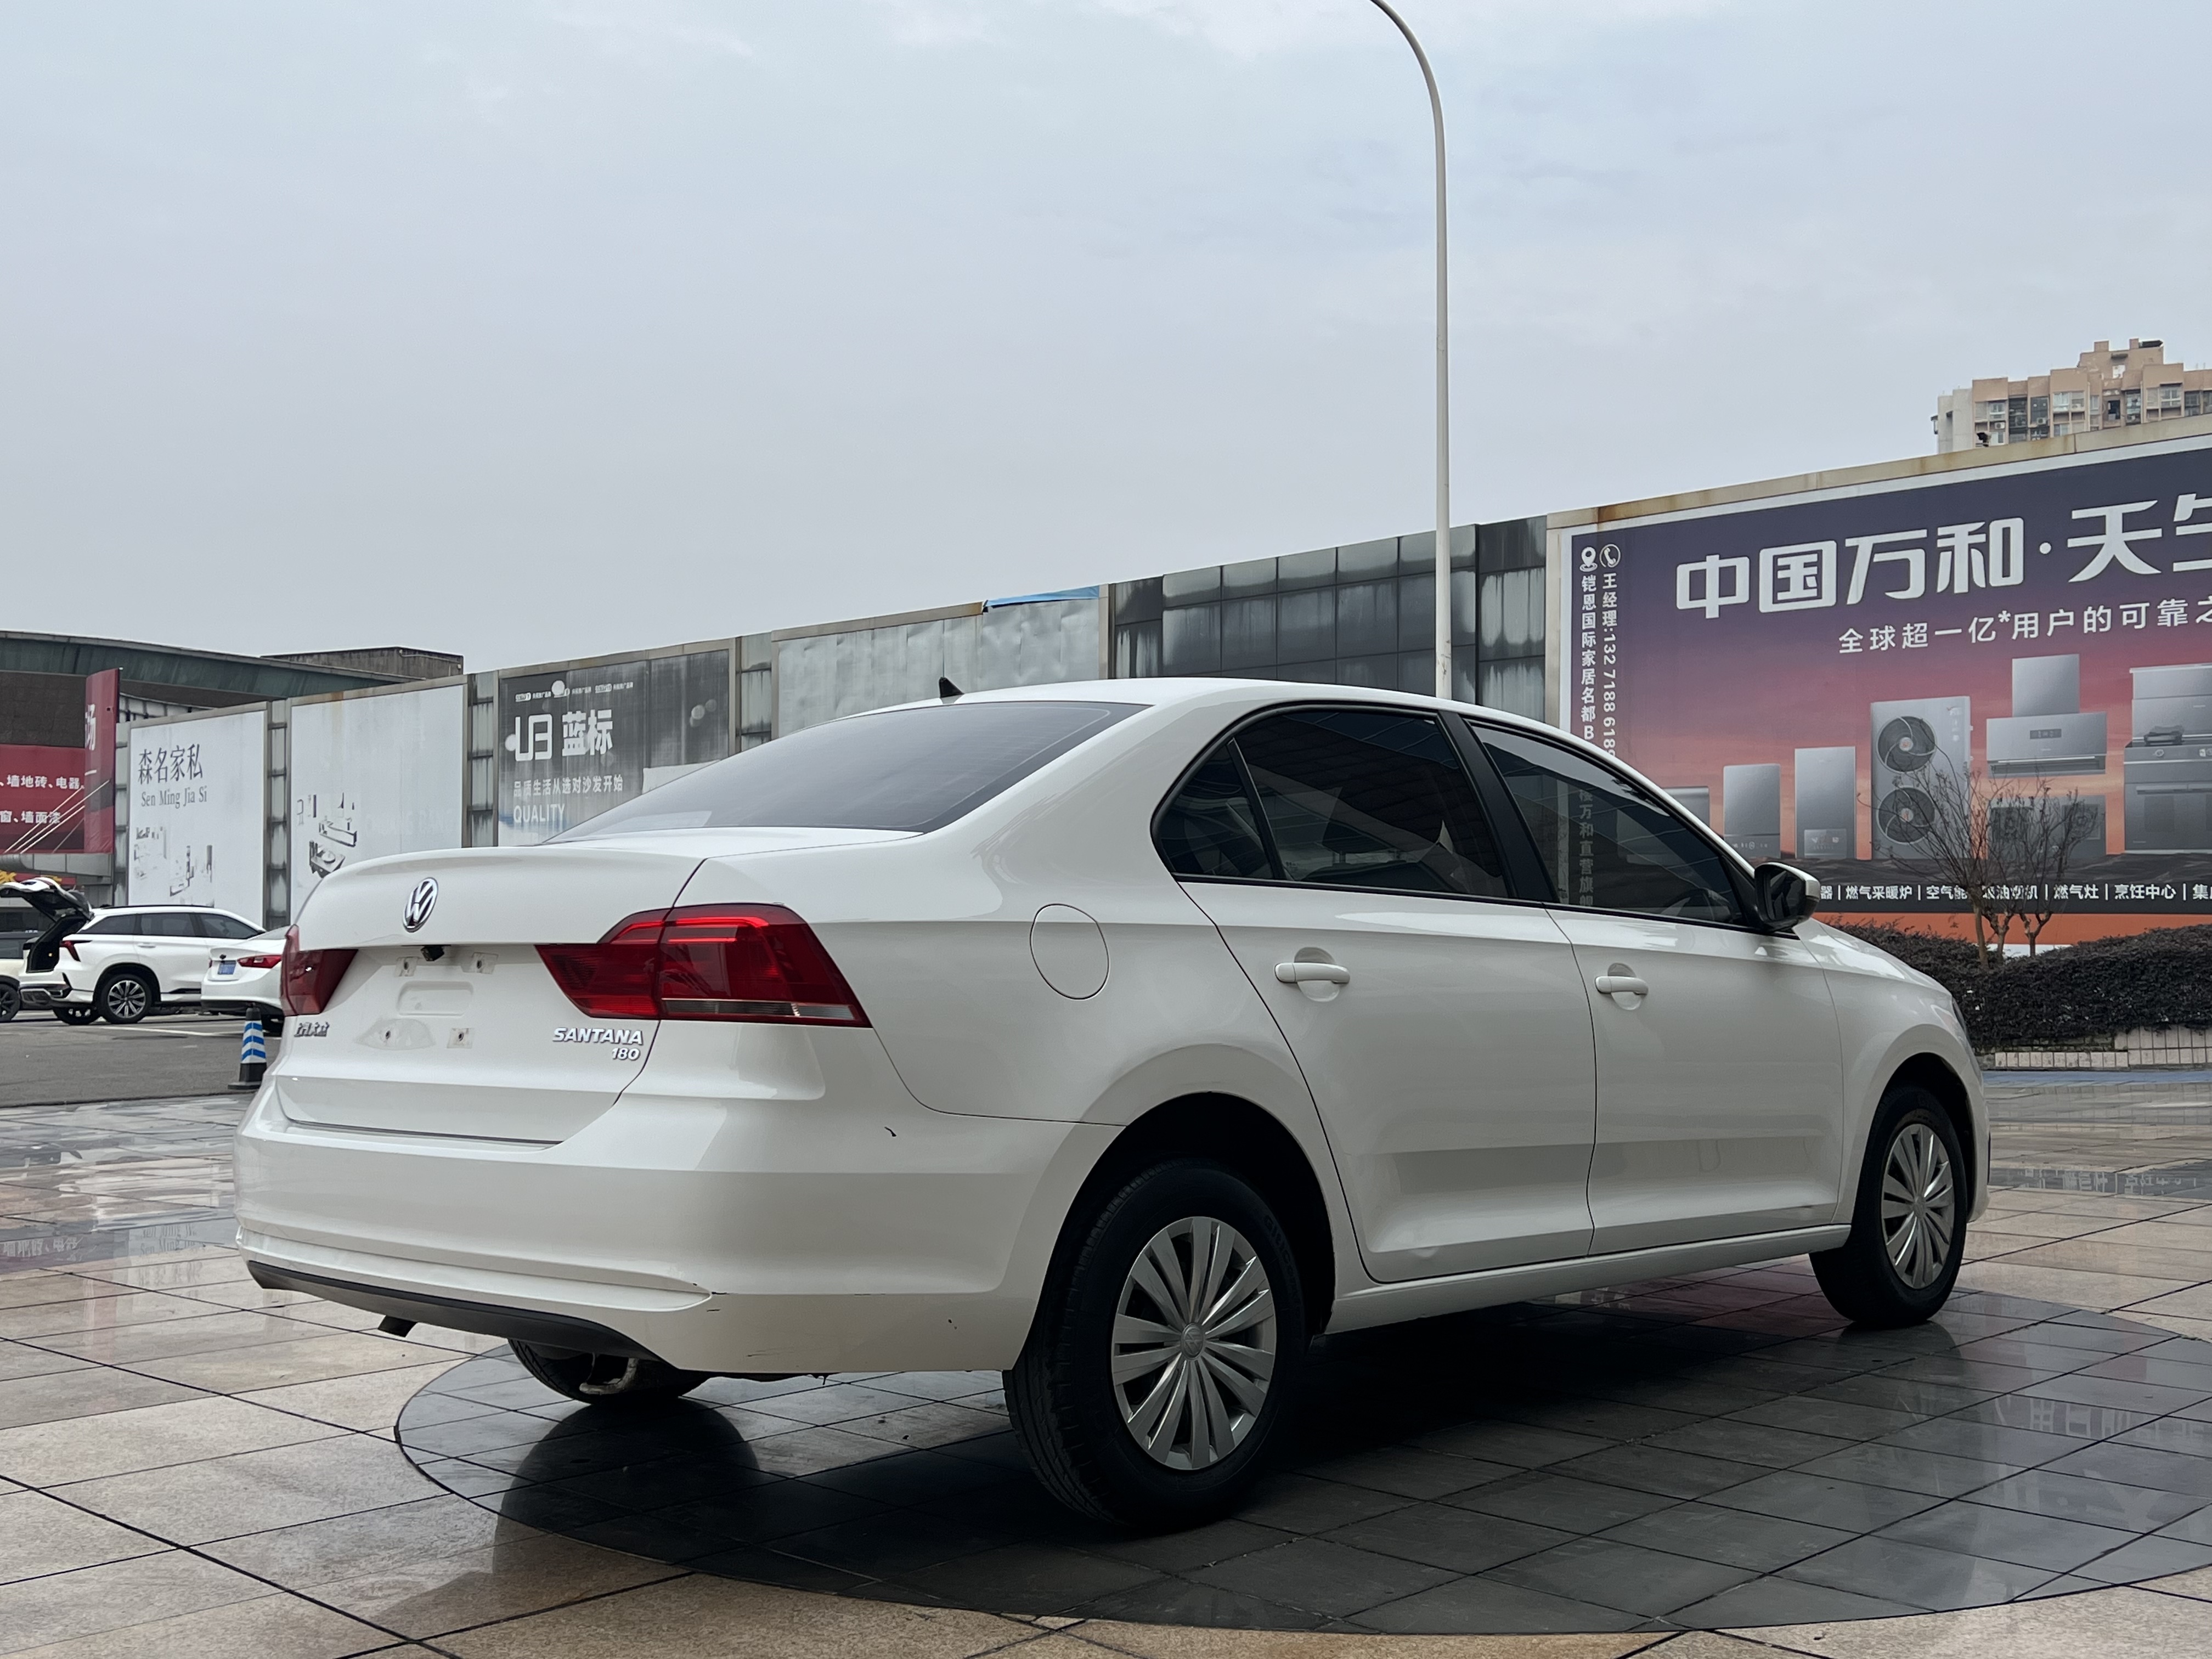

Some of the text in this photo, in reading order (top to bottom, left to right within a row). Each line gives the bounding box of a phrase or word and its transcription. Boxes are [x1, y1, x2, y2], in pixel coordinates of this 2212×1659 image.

[562, 709, 613, 757] 蓝标
[138, 743, 204, 785] 森名家私
[513, 774, 623, 797] 品质生活从选对沙发开始
[141, 786, 207, 809] Sen Ming Jia Si
[513, 803, 565, 824] QUALITY
[1846, 885, 1912, 900] 燃气采暖炉
[2053, 884, 2099, 900] 燃气灶
[2114, 884, 2177, 900] 烹饪中心
[2192, 884, 2212, 900] 集
[552, 1027, 644, 1045] SANTANA
[611, 1046, 640, 1061] 180
